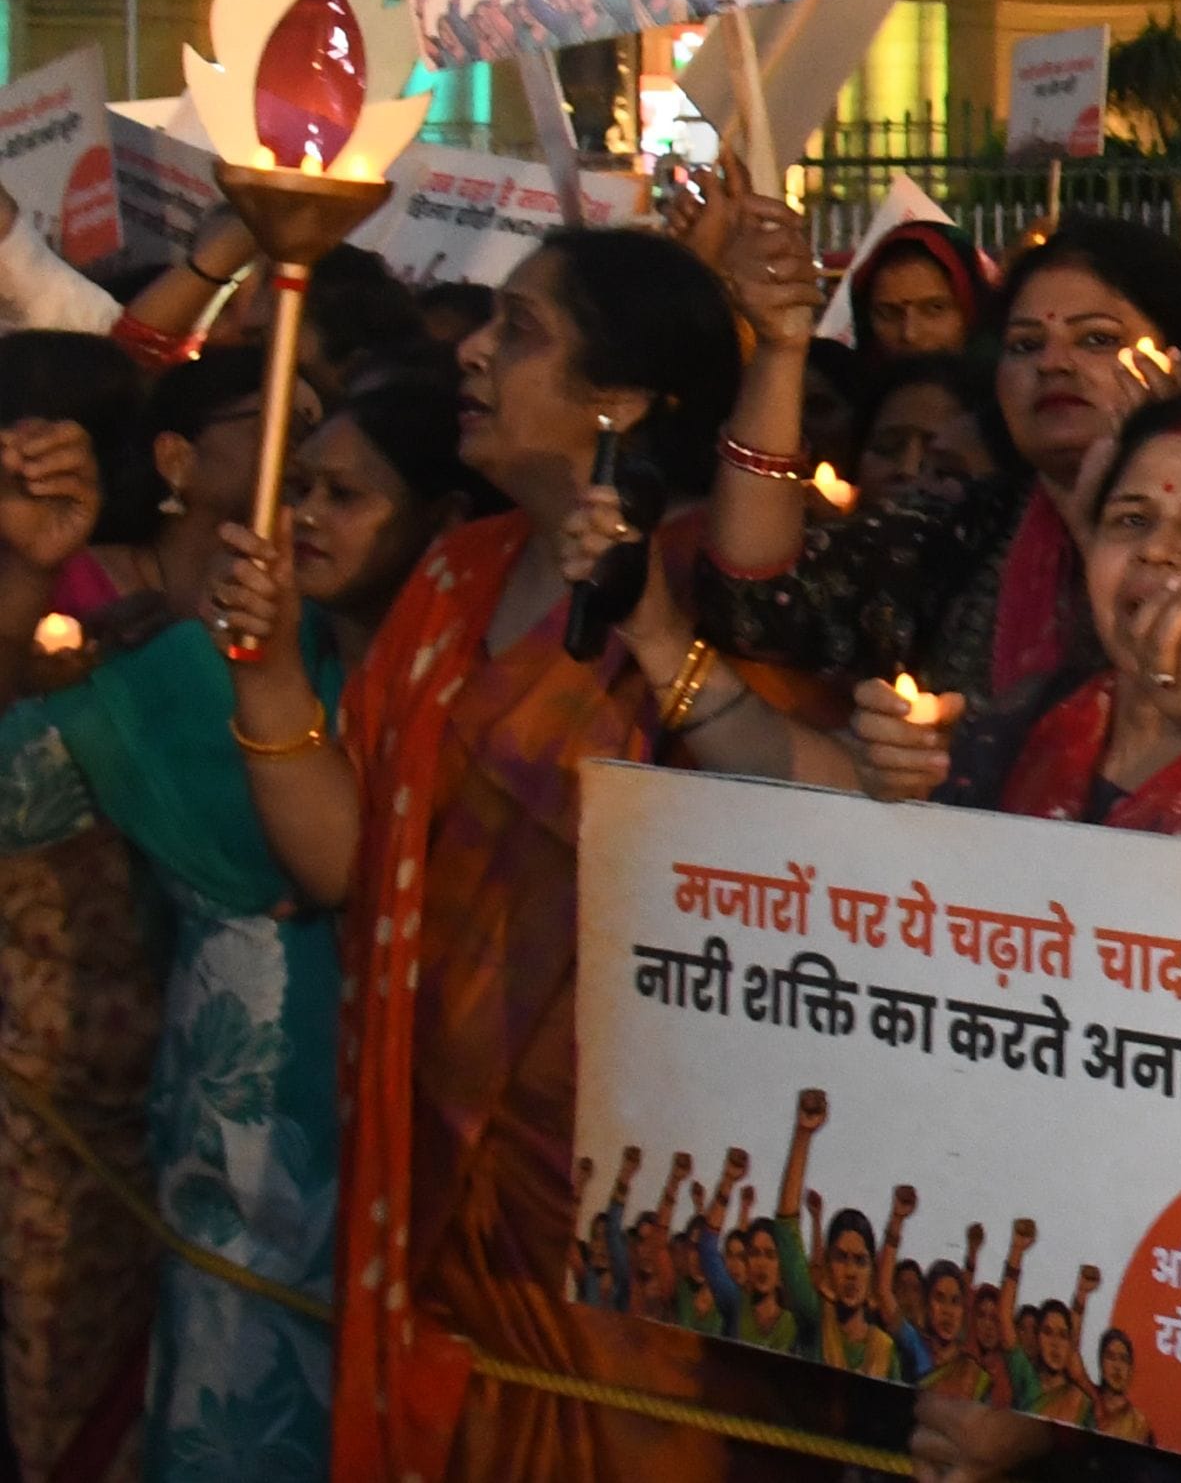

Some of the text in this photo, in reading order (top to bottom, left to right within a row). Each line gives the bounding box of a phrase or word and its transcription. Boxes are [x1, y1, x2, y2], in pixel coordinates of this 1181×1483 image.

[671, 860, 817, 936] मजारों
[827, 885, 891, 949] पर
[896, 879, 937, 958] ये
[945, 900, 1076, 989] चढ़ाते
[634, 935, 733, 1016] नारी
[743, 949, 859, 1037] शक्ति
[867, 984, 937, 1054] का
[946, 993, 1070, 1079] करते
